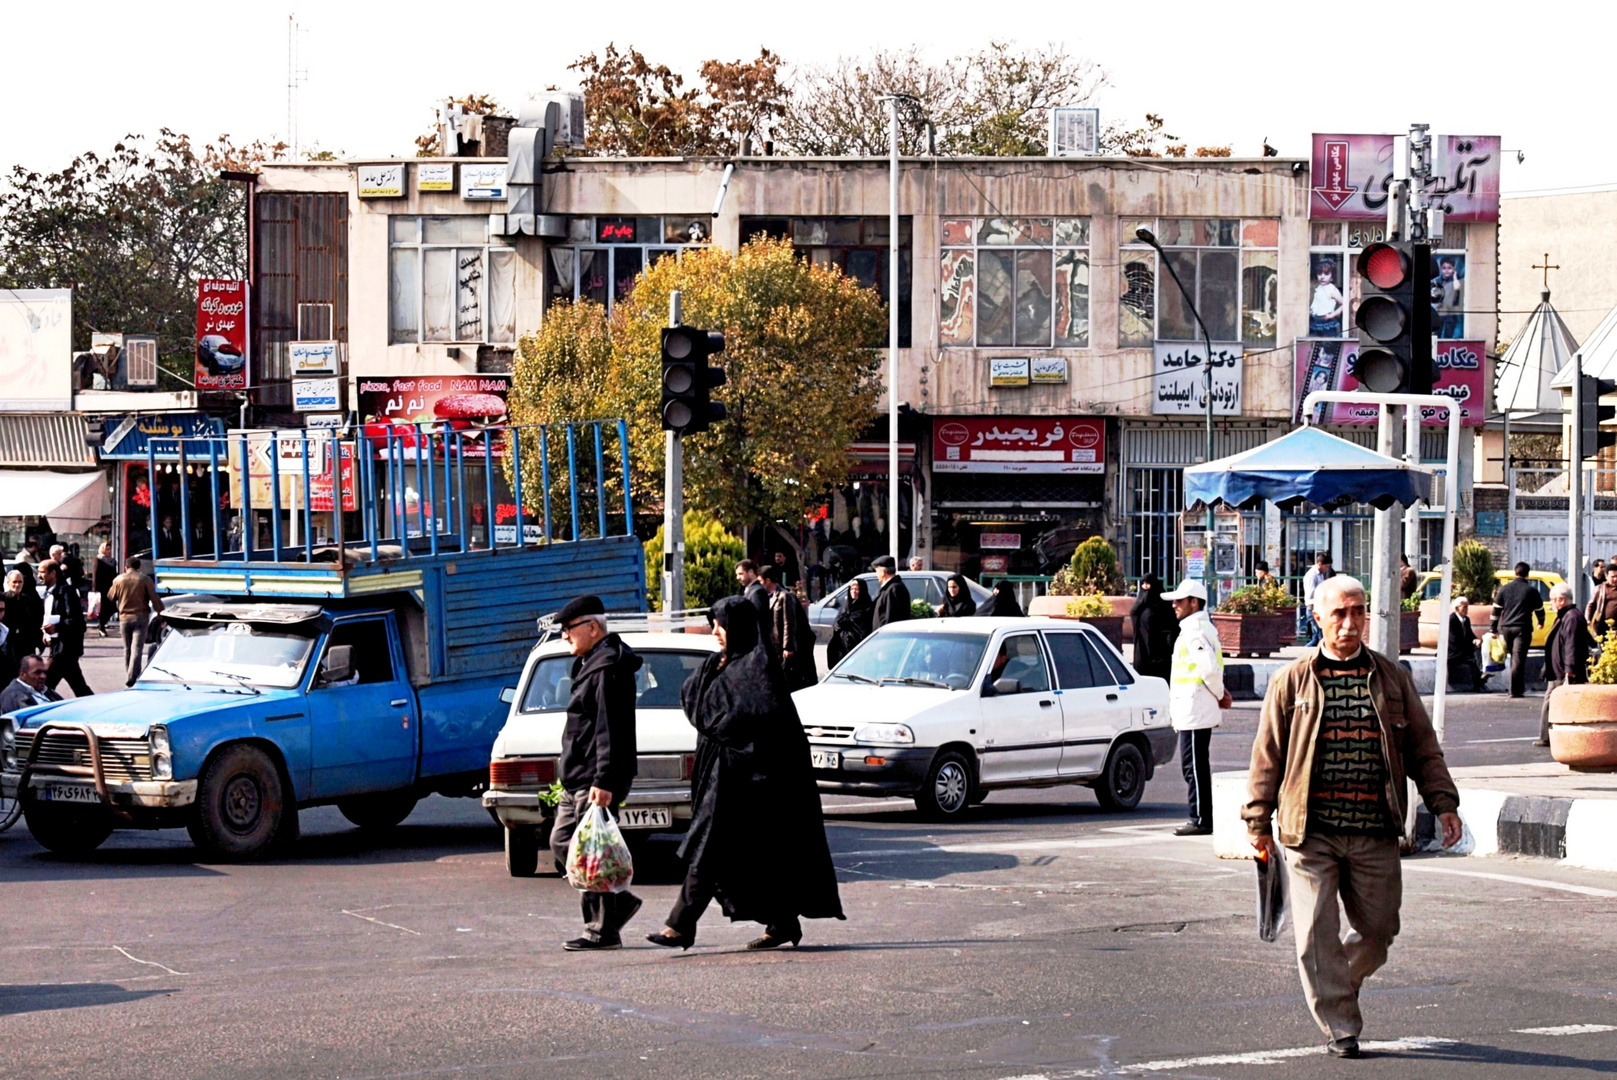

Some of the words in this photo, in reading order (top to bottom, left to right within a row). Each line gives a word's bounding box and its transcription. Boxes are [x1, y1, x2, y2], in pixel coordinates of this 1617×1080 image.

[1162, 348, 1202, 368] حامد
[360, 380, 391, 395] pizza,
[393, 379, 416, 392] fast
[417, 379, 442, 392] food
[450, 379, 477, 391] NAM
[479, 379, 507, 391] NAM
[970, 421, 1066, 447] فریجیدر
